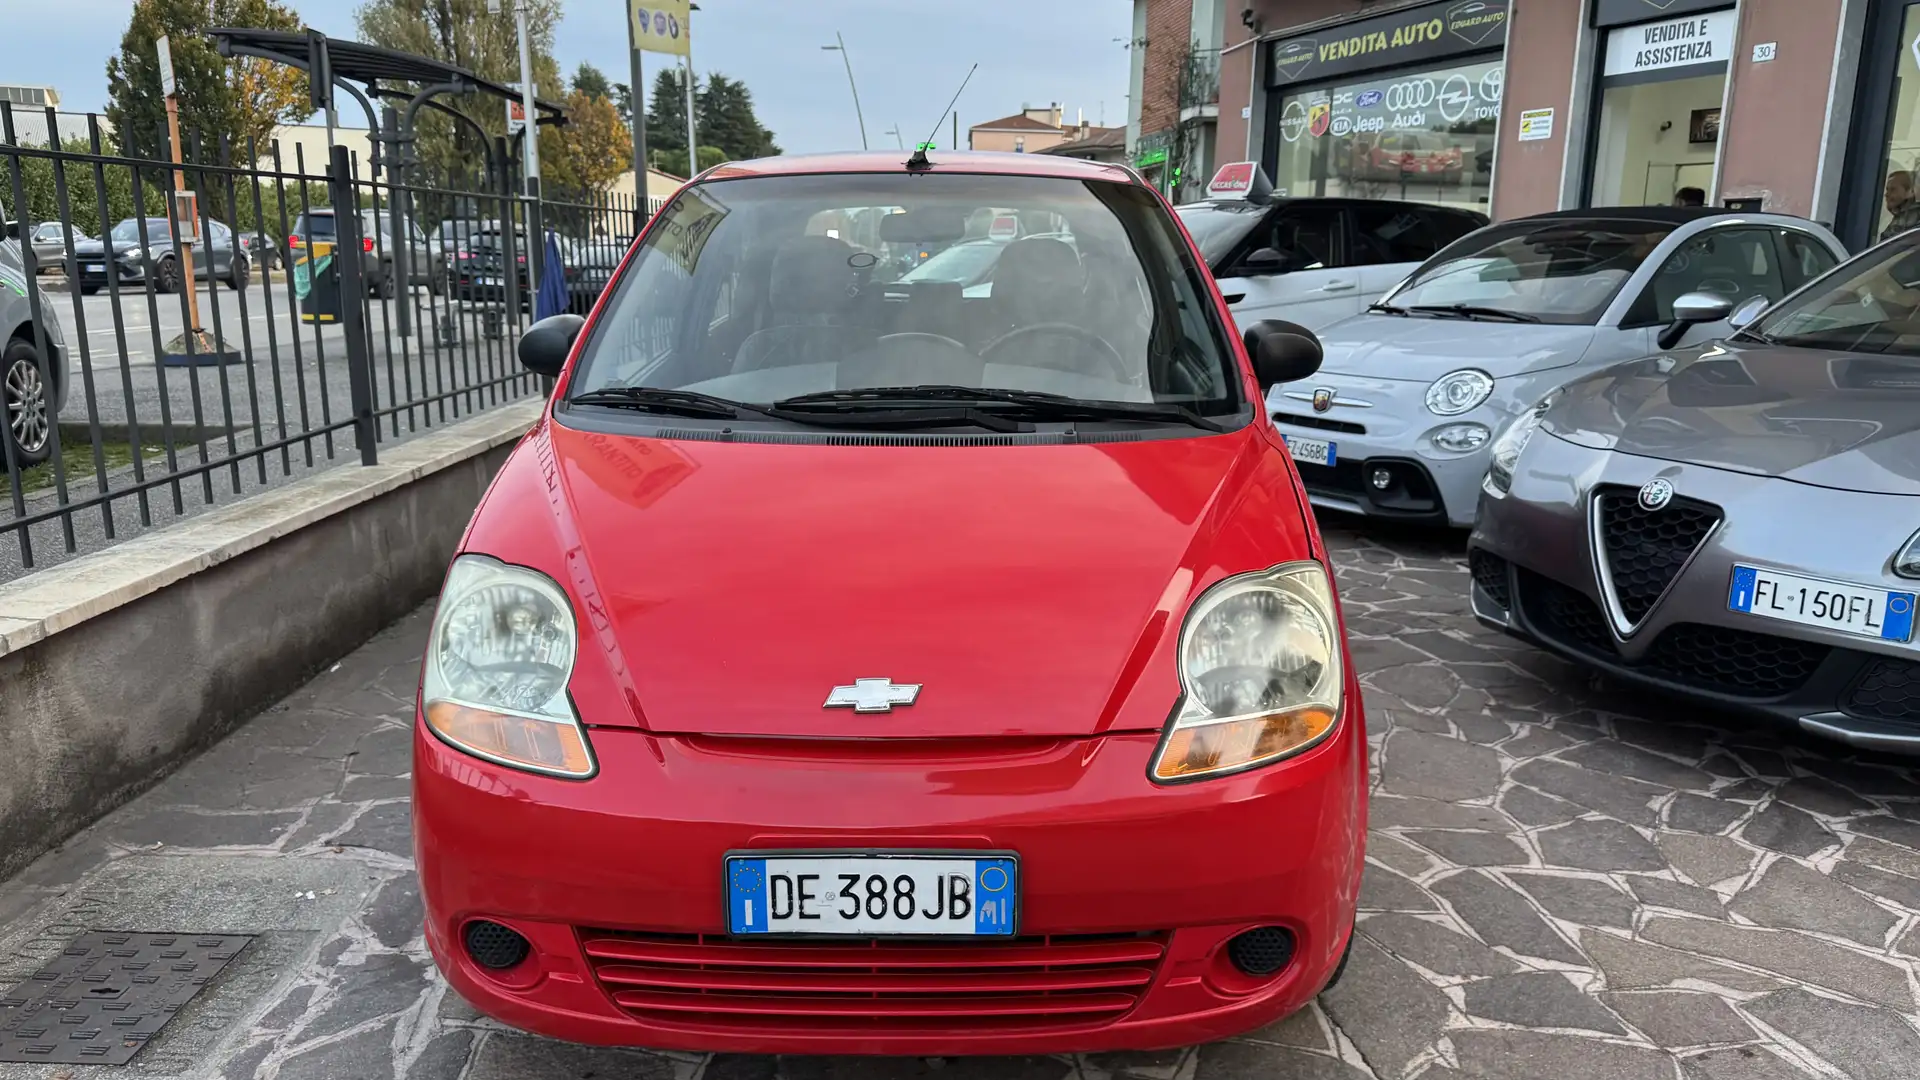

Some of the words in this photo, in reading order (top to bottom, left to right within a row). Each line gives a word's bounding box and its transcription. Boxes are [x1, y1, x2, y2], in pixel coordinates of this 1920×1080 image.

[1451, 16, 1482, 30] EDUARD
[1481, 11, 1504, 23] AUTO
[1319, 32, 1387, 63] VENDITA
[1391, 18, 1443, 48] AUTO
[1644, 20, 1695, 44] VENDITA
[1699, 18, 1708, 36] E
[1634, 40, 1712, 67] ASSISTENZA
[1757, 45, 1770, 58] 30
[1360, 91, 1380, 107] Ford
[1333, 121, 1349, 131] KIA
[1352, 114, 1384, 134] Jeep
[1391, 110, 1426, 128] Audi
[1755, 580, 1785, 610] FL
[1799, 587, 1880, 628] 150FL
[770, 874, 821, 920] DE
